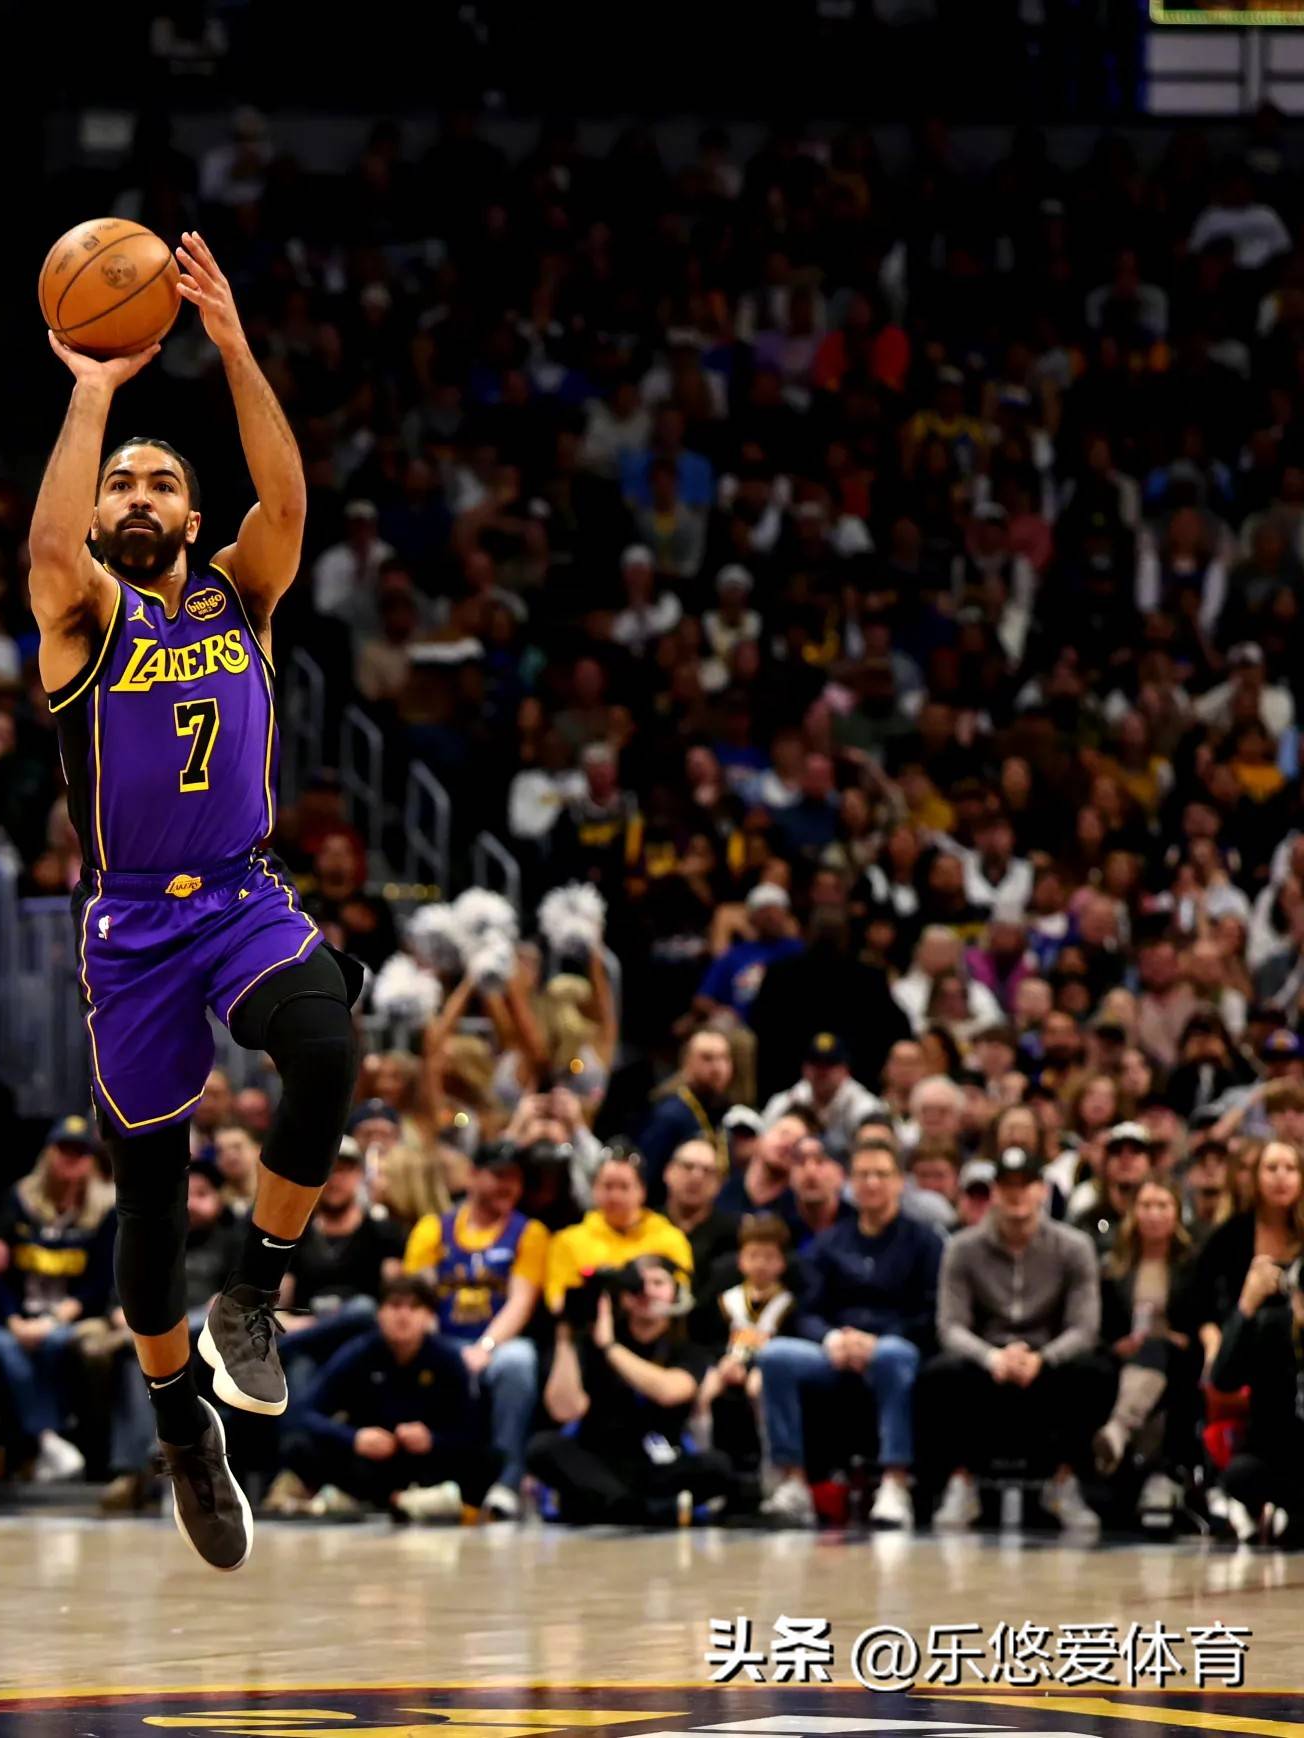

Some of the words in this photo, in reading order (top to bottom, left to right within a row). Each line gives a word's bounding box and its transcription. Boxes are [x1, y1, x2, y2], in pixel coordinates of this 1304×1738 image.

[188, 594, 222, 613] bibigo
[109, 629, 249, 692] LAKERS
[173, 698, 220, 793] 7
